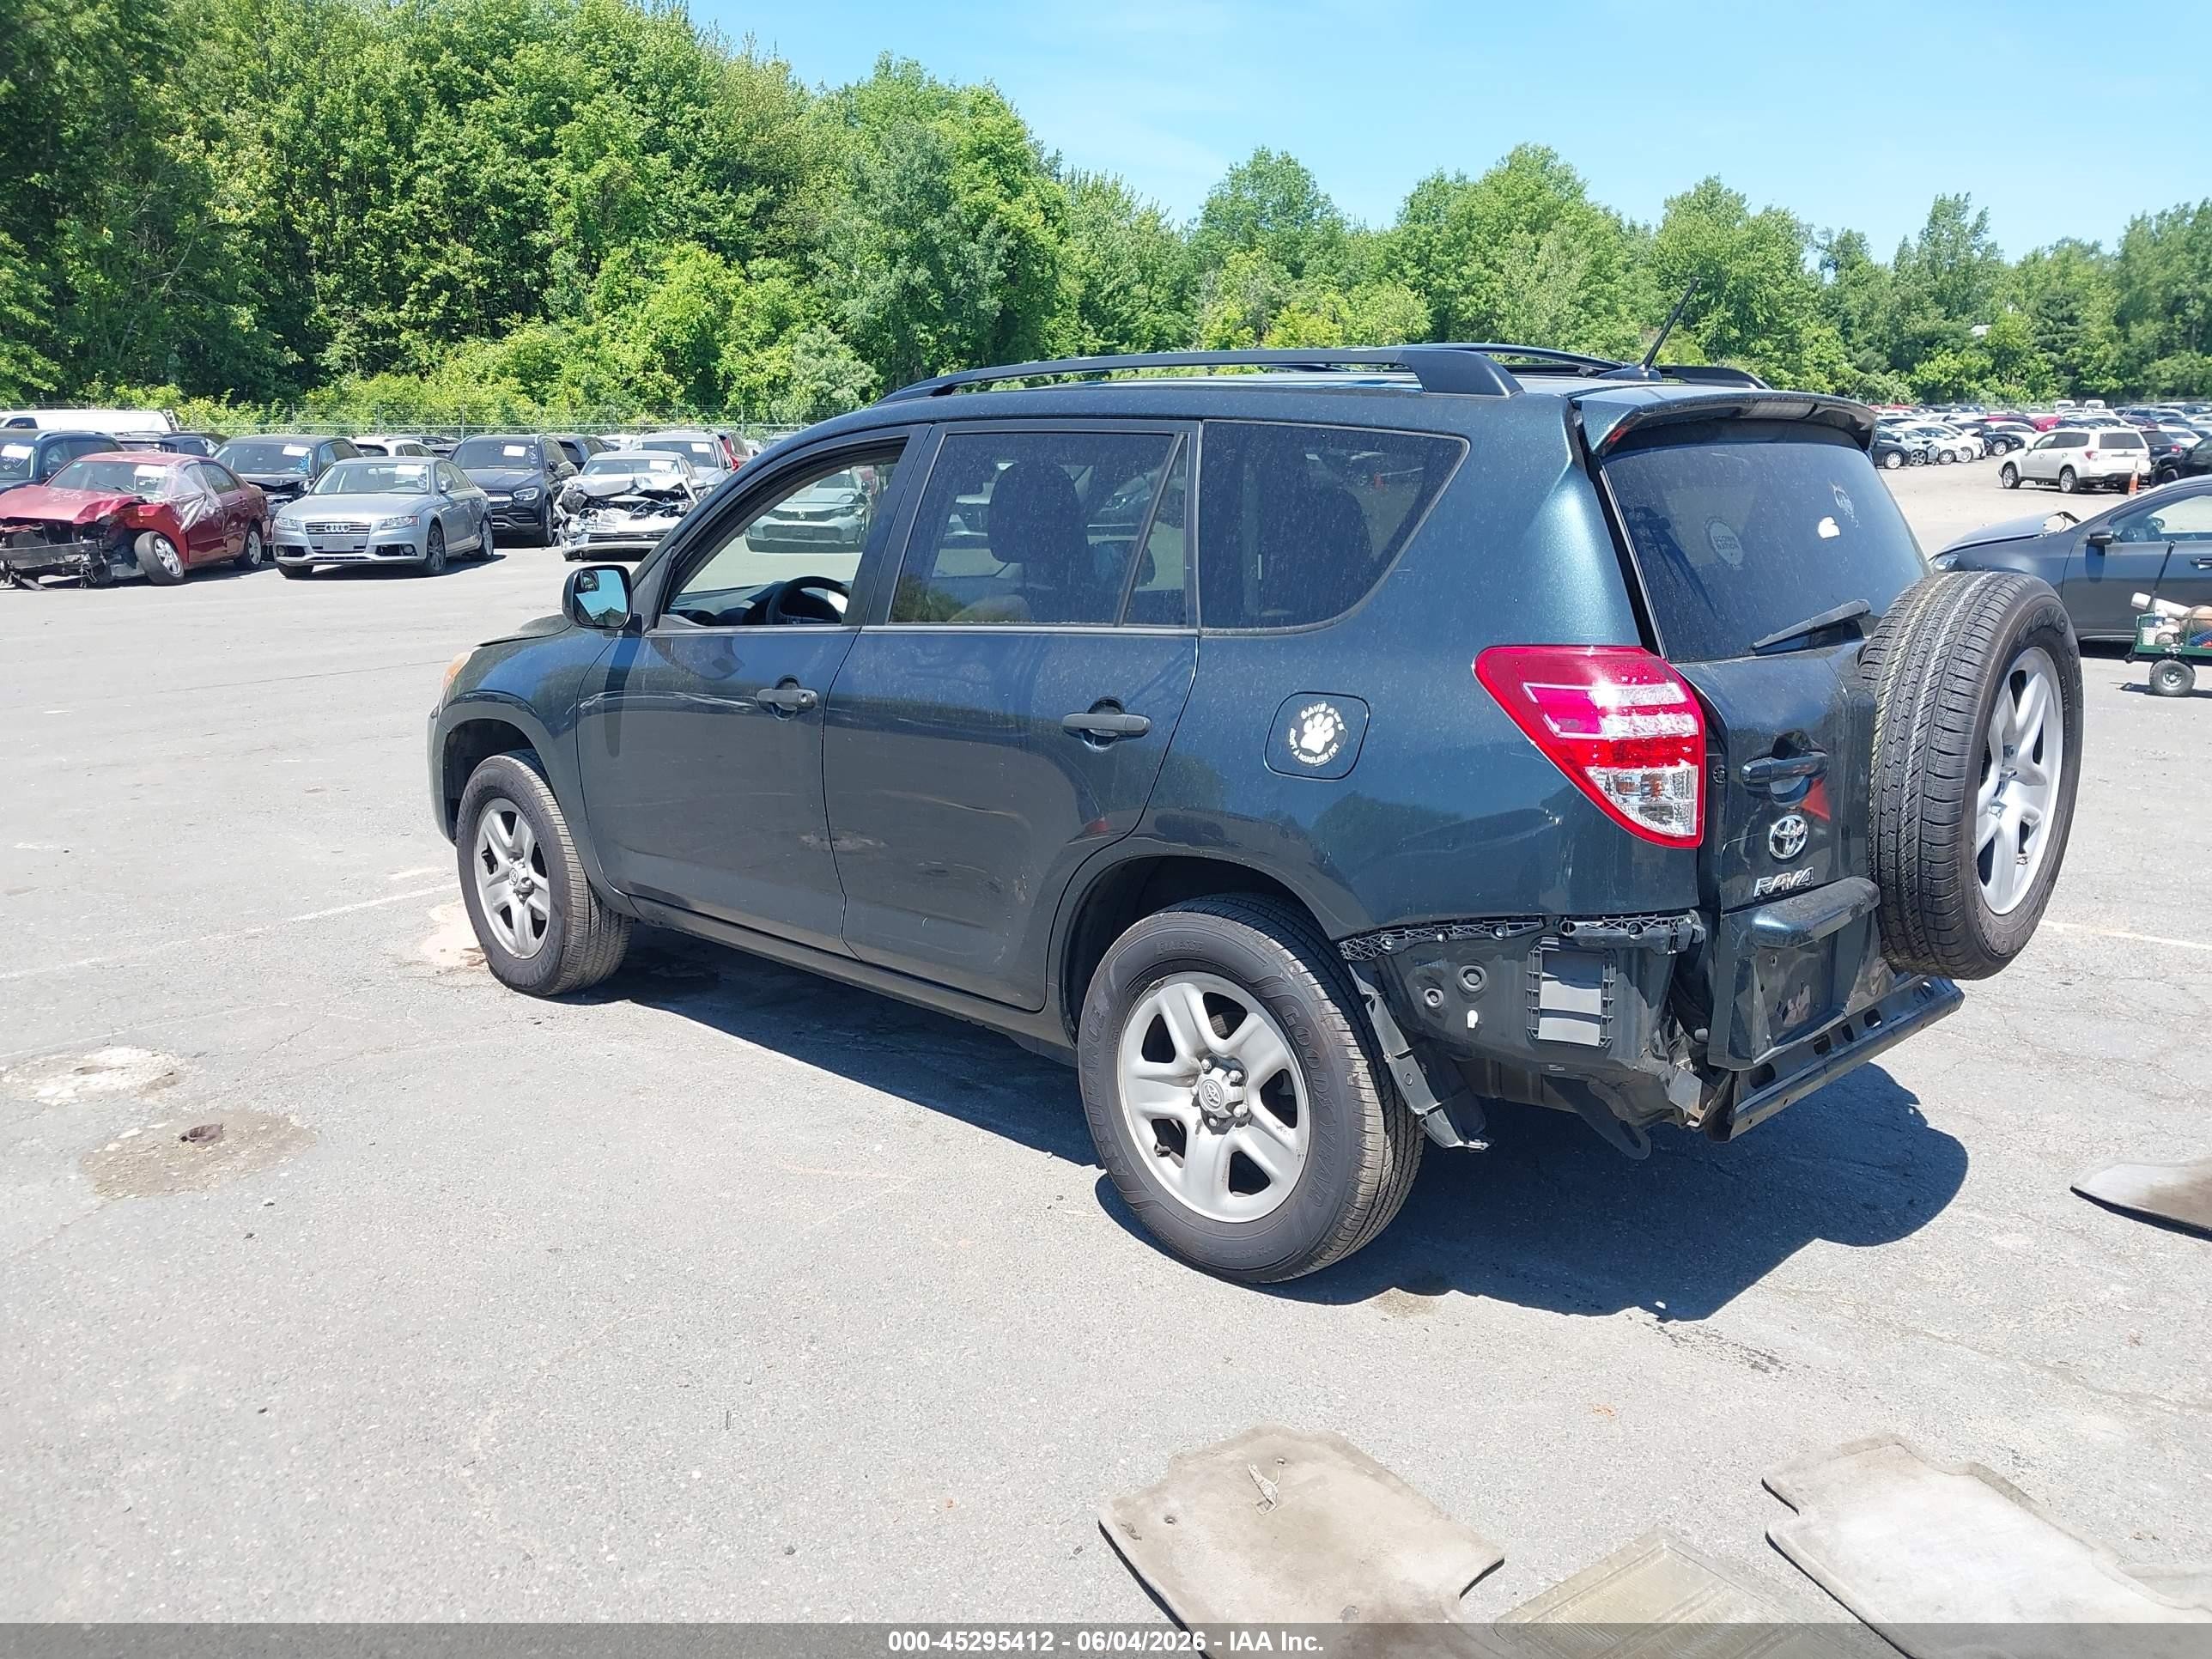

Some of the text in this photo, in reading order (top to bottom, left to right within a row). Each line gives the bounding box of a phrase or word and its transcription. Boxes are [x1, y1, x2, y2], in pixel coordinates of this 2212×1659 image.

[1300, 701, 1328, 720] SAVE
[1753, 866, 1814, 897] RAV4
[1084, 1008, 1130, 1176] ASSURANCE
[1282, 1003, 1337, 1209] GOODYEAR
